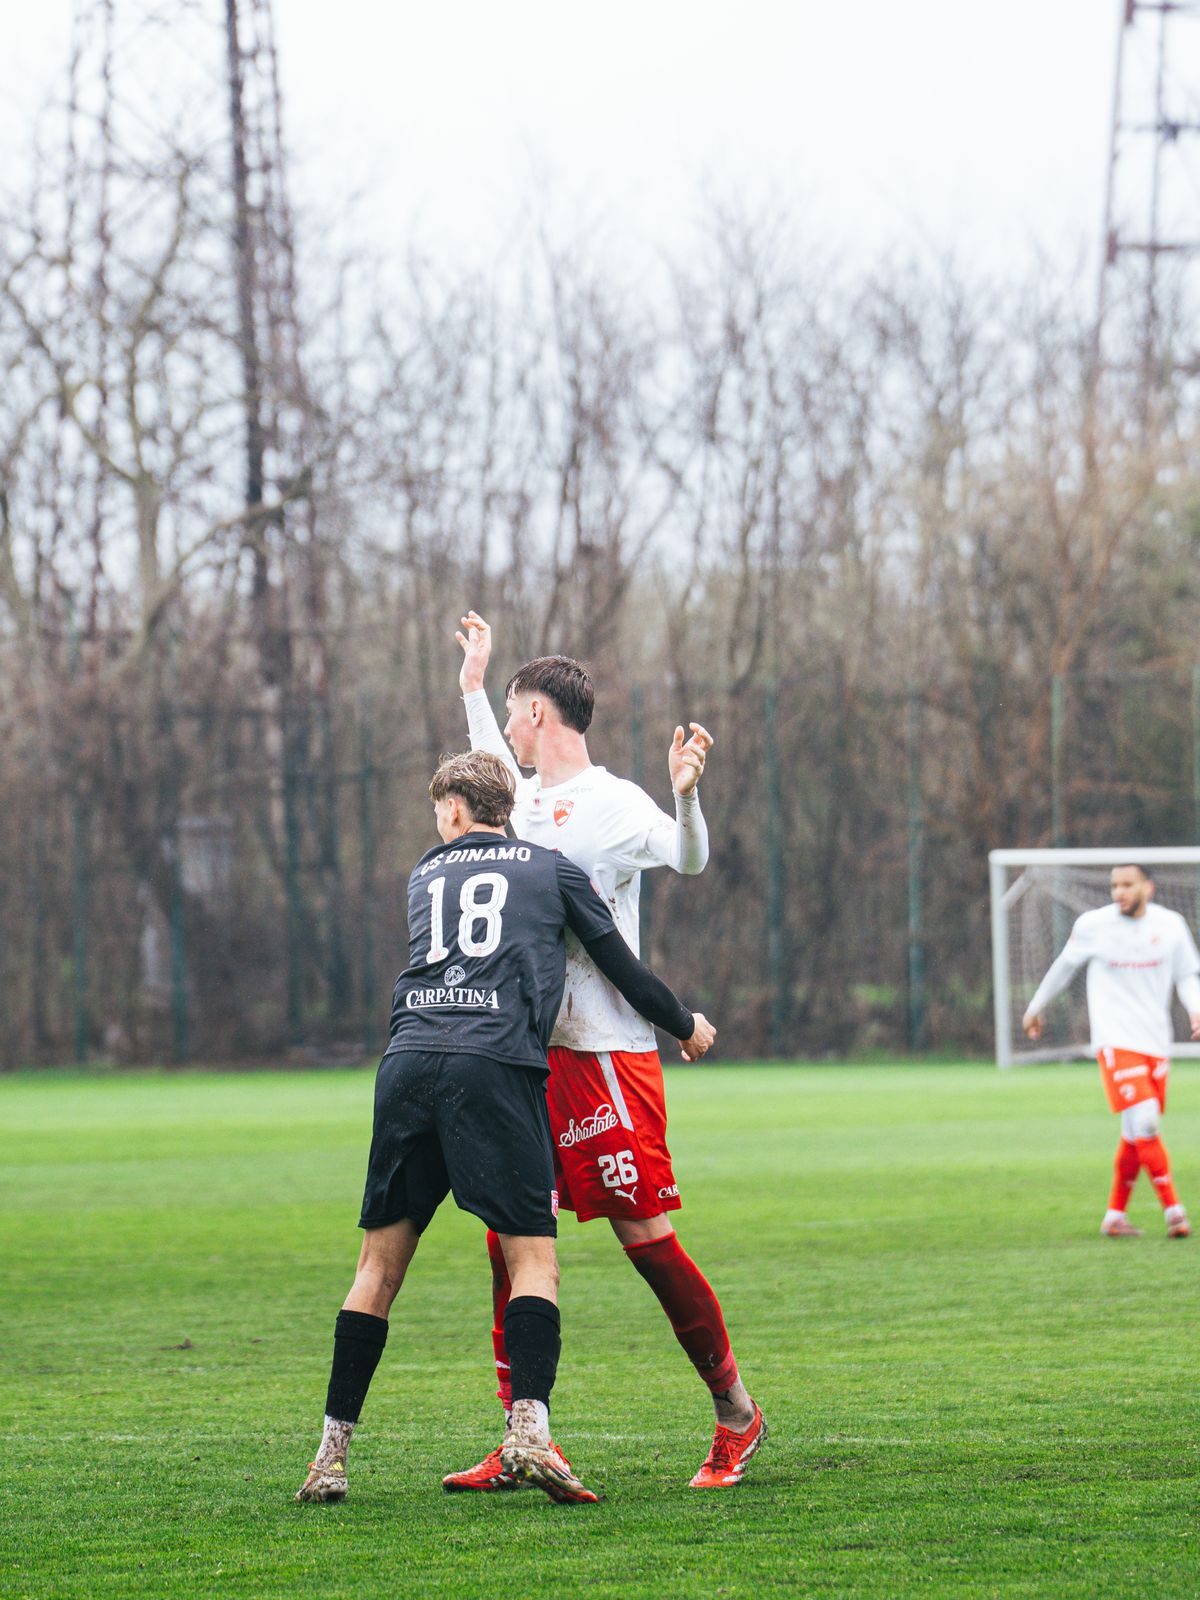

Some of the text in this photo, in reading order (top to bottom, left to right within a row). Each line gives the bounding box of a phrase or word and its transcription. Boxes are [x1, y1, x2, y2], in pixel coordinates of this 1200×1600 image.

[445, 846, 531, 864] DINAMO
[426, 872, 509, 964] 18
[406, 987, 500, 1009] CARPATINA
[558, 1103, 618, 1147] Stradale
[597, 1149, 639, 1187] 26
